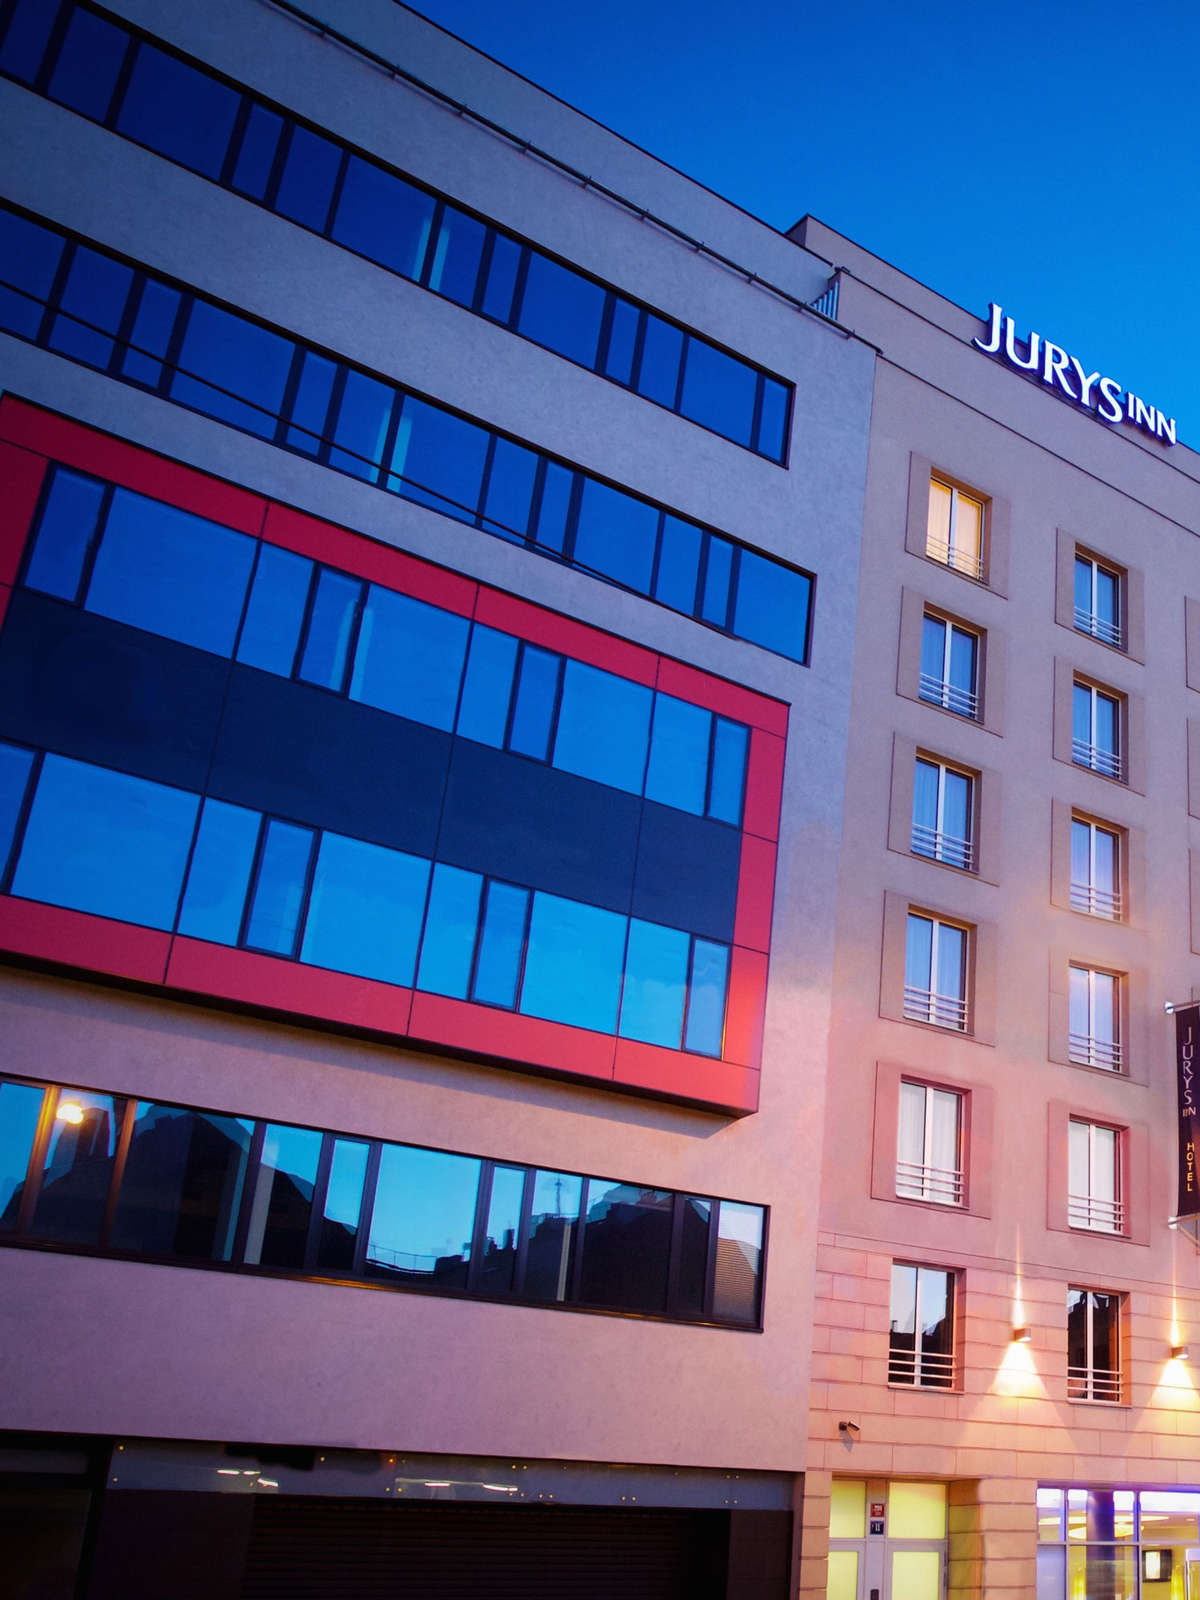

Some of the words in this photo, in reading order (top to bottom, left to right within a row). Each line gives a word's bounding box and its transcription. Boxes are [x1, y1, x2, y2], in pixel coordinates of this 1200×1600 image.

[972, 302, 1123, 424] JURYS
[1127, 392, 1177, 447] INN
[1182, 1026, 1194, 1105] JURYS
[1186, 1143, 1195, 1192] HOTEL
